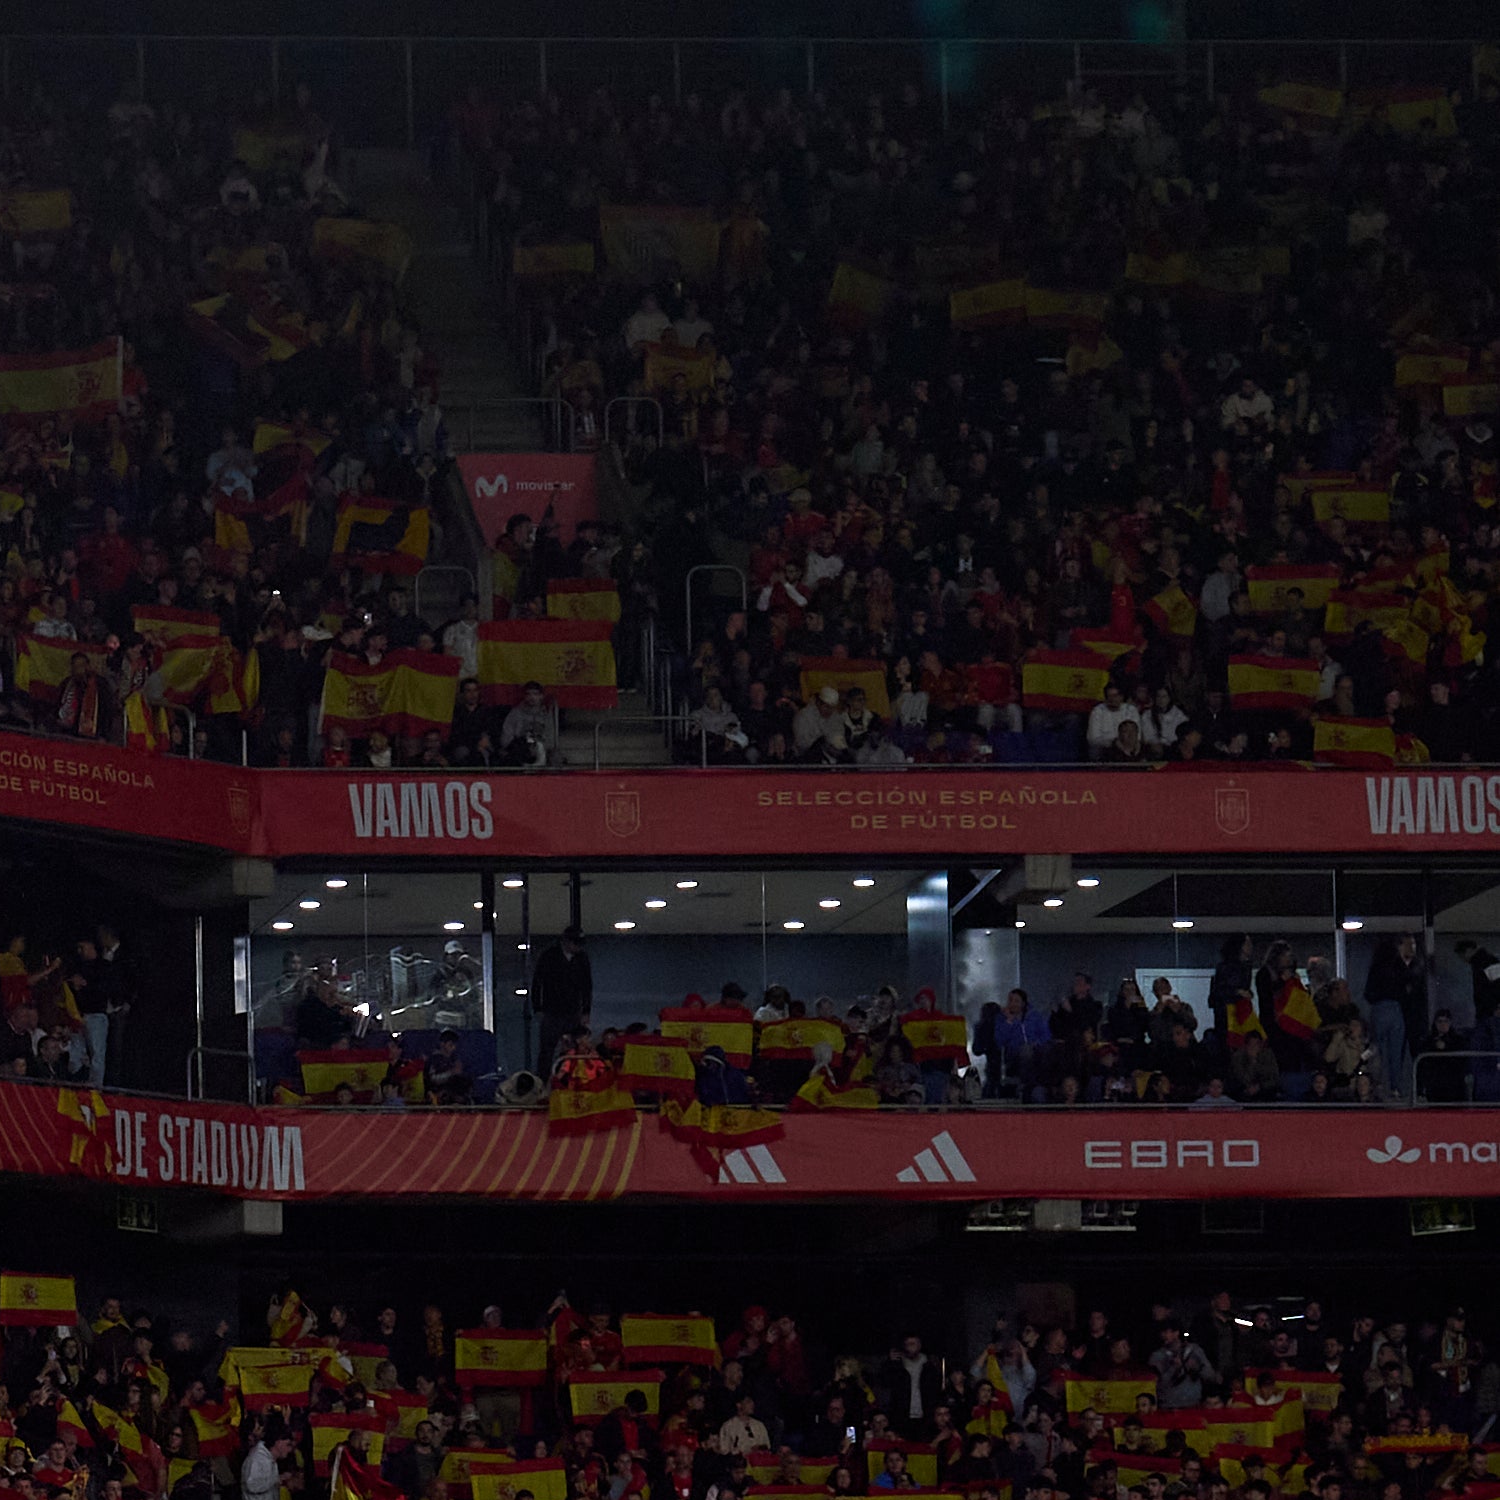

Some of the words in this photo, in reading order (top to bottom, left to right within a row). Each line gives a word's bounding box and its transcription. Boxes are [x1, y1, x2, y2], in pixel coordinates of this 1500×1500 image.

[34, 772, 108, 806] FÚTBOL
[49, 755, 157, 790] ESPAÑOLA
[348, 780, 494, 840] VAMOS
[756, 785, 928, 807] SELECCIÓN
[939, 785, 1098, 806] ESPAÑOLA
[1365, 776, 1500, 839] VAMOS
[850, 814, 889, 830] DE
[900, 810, 1018, 830] FÚTBOL
[158, 1114, 306, 1191] STADIUM
[1084, 1139, 1260, 1169] EBRO
